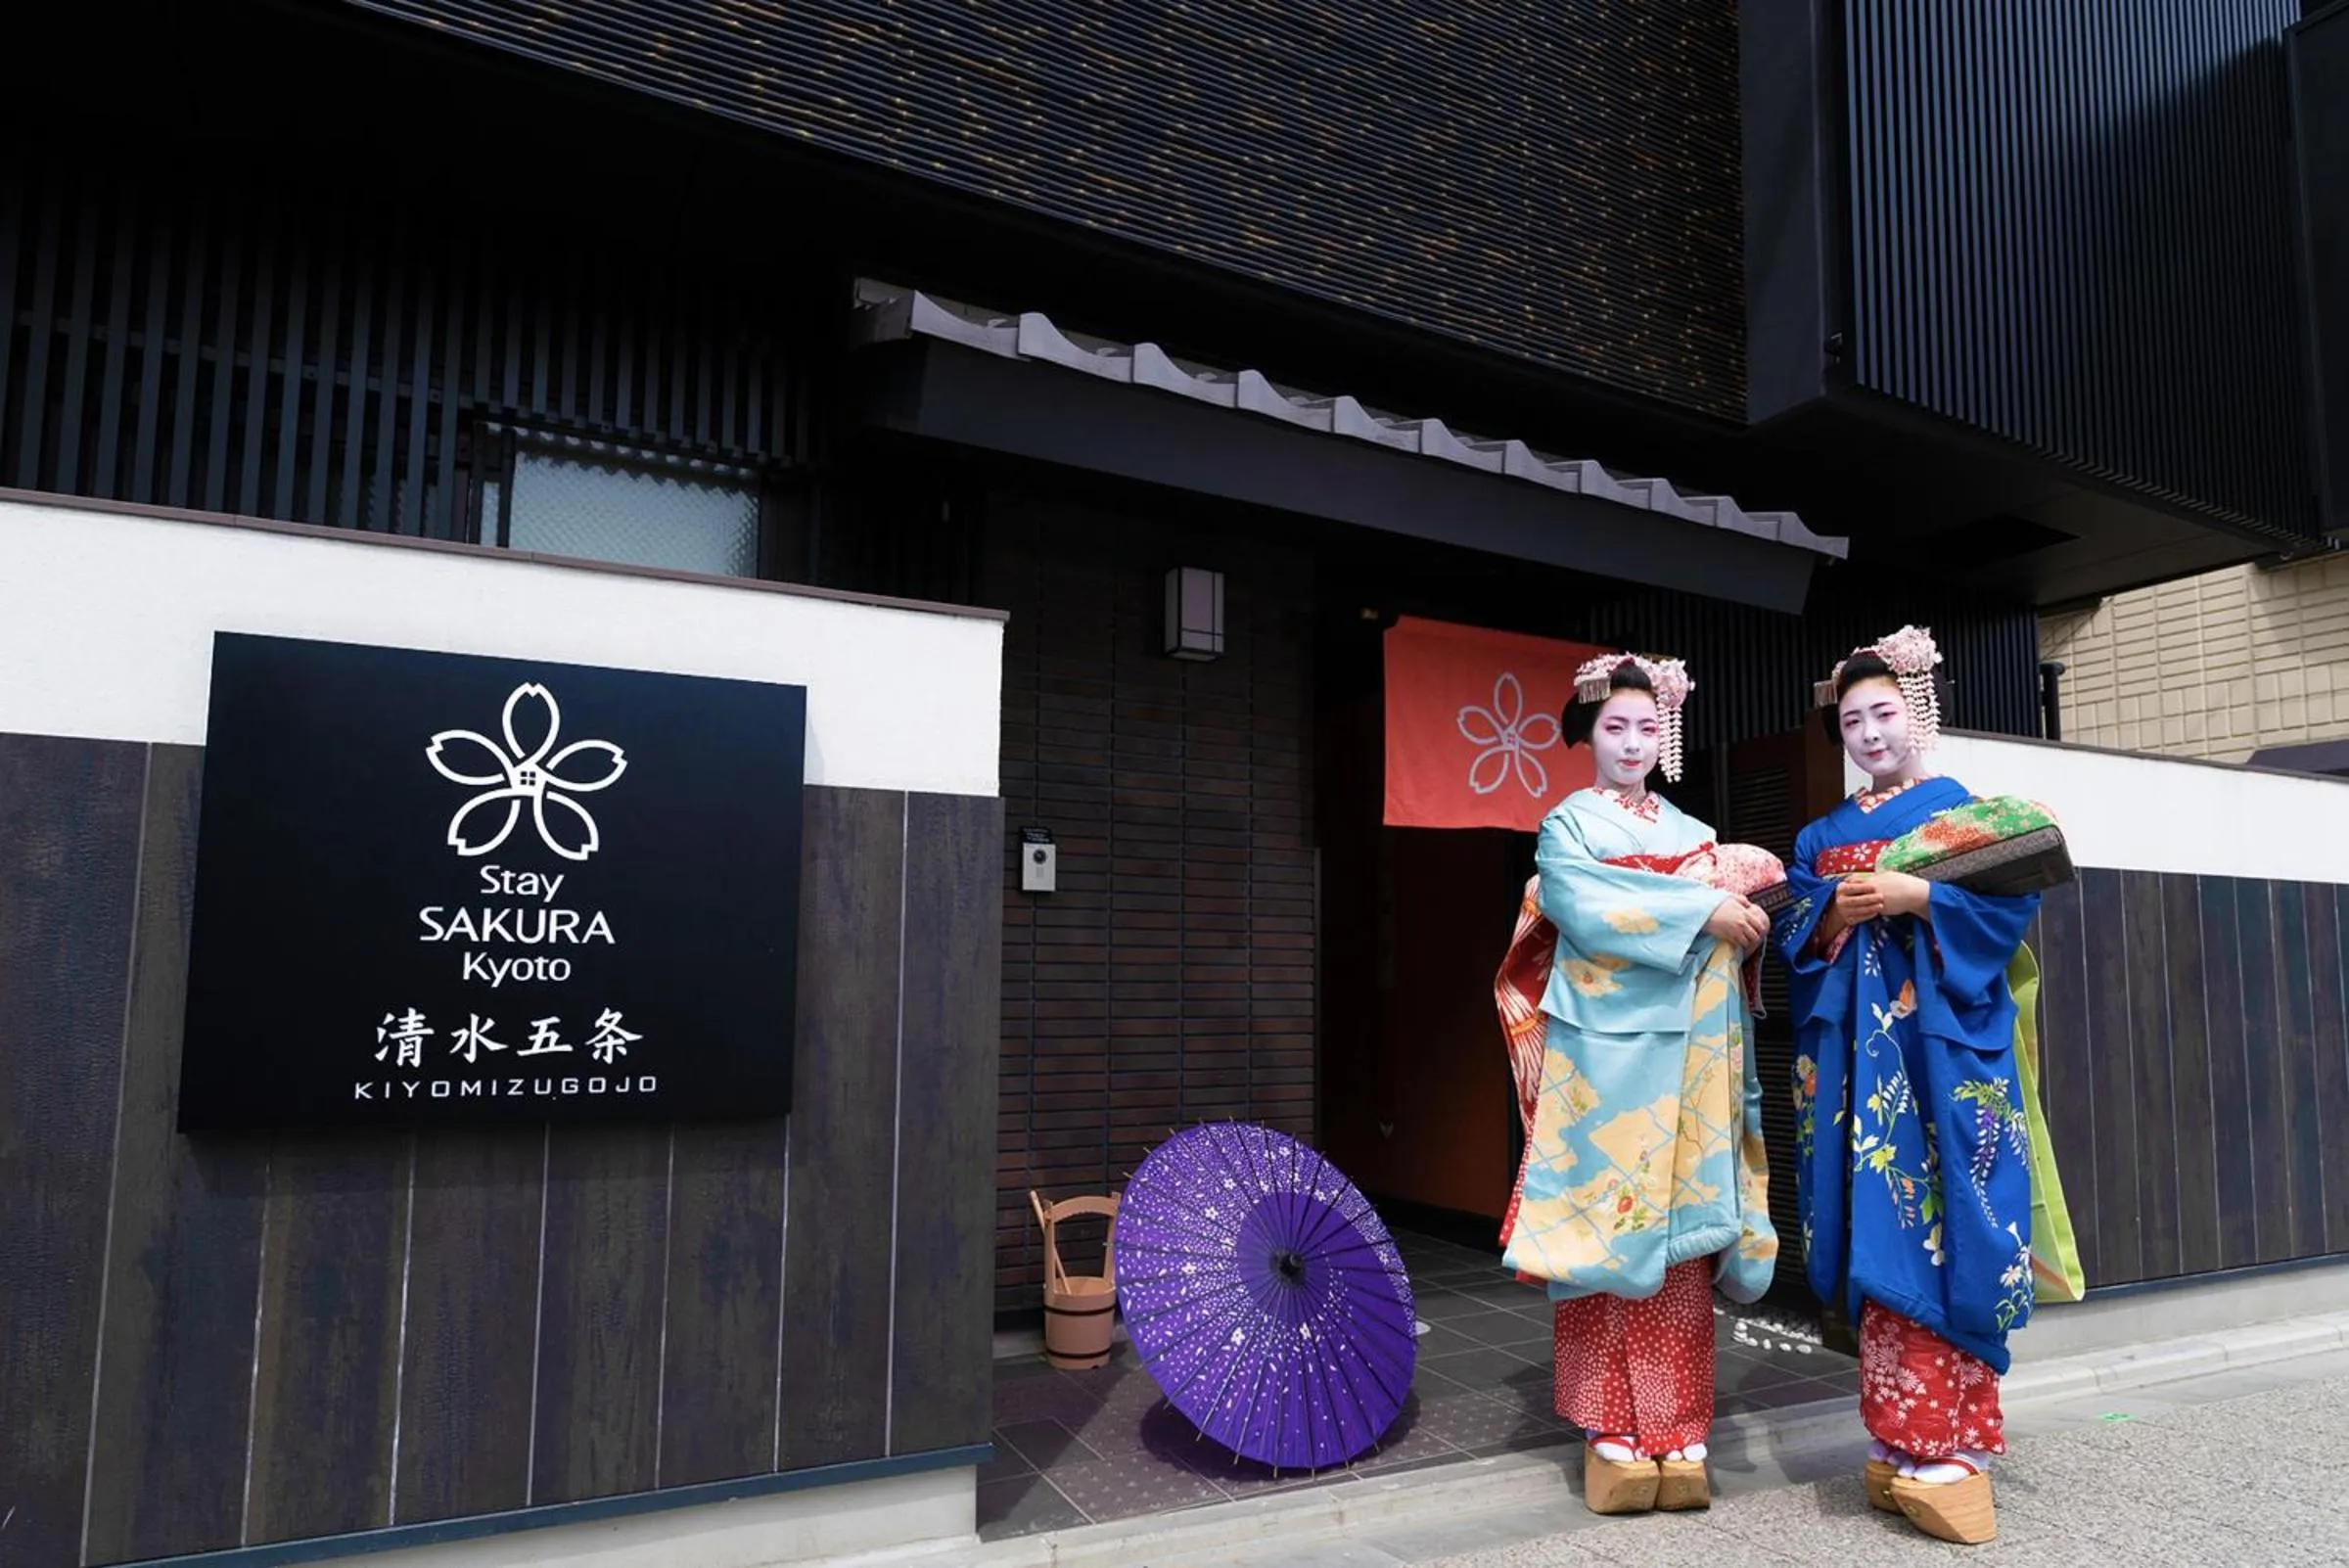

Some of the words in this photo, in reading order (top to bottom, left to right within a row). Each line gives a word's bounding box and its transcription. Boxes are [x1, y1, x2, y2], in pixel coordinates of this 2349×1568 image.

[480, 864, 565, 903] Stay
[419, 906, 616, 945] SAKURA
[462, 951, 572, 989] Kyoto
[375, 1007, 643, 1068] 清水五条
[354, 1076, 657, 1099] KIYOMIZUGOJO
